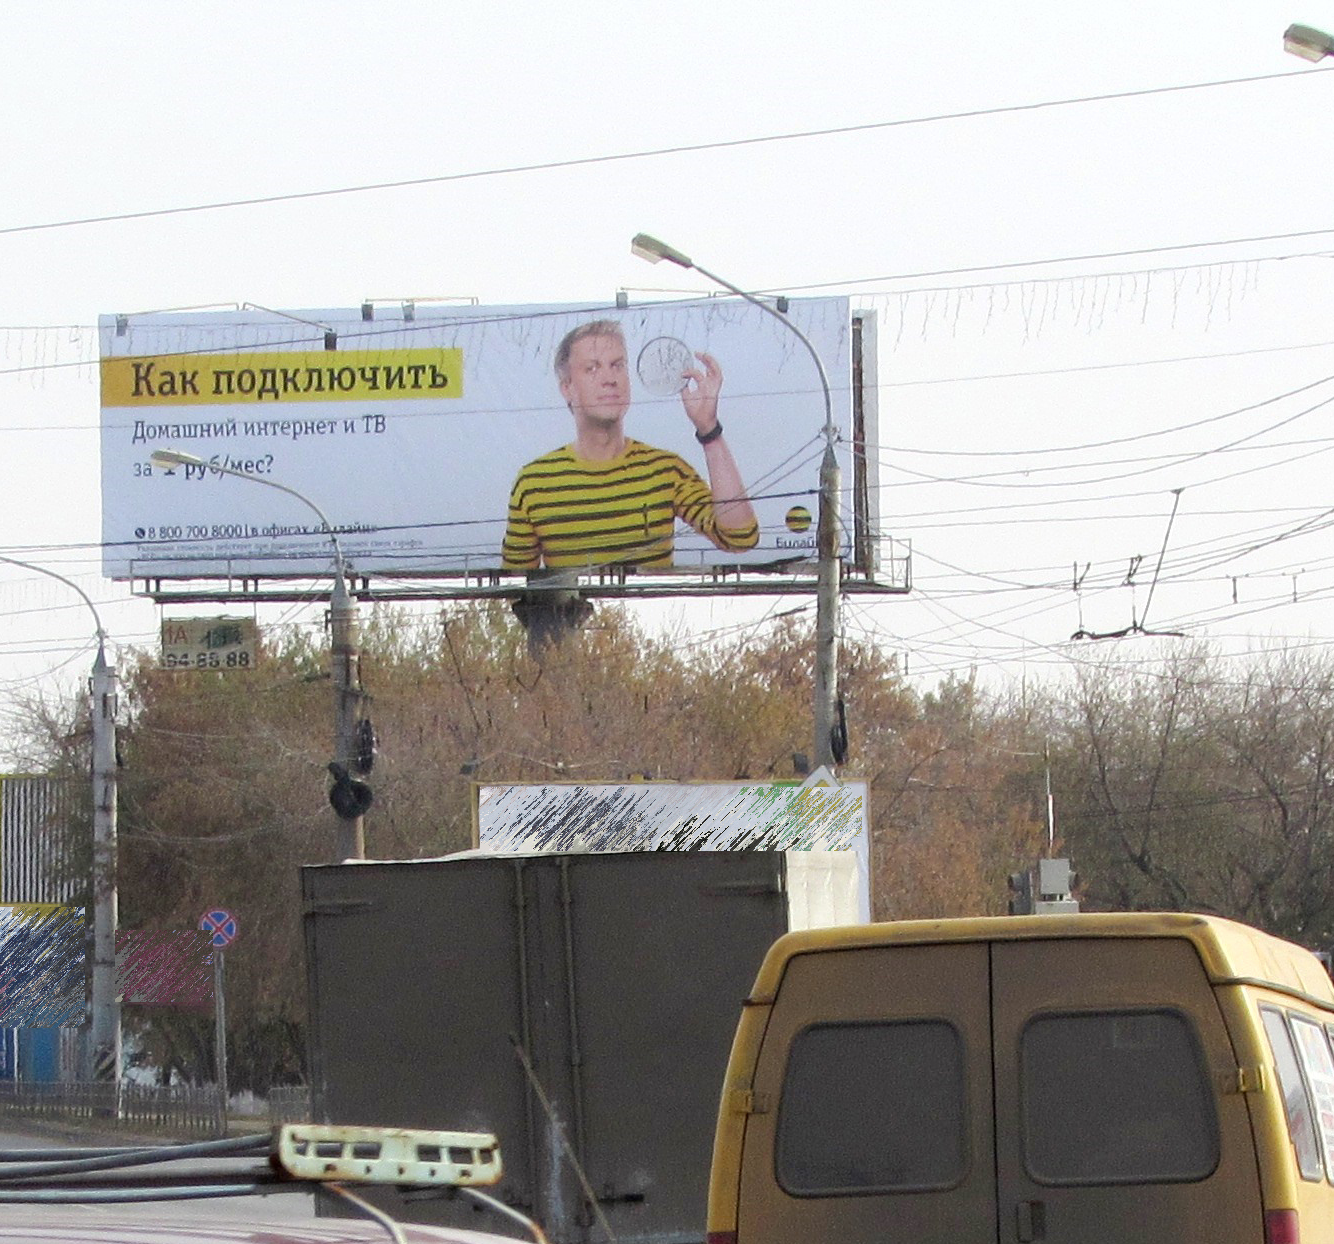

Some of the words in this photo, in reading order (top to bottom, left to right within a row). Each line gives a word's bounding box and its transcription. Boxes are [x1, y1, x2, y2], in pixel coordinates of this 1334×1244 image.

[132, 363, 199, 396] Как
[212, 364, 449, 399] подключить
[132, 419, 237, 444] Домашний
[244, 418, 336, 439] интернет
[344, 420, 355, 434] и
[363, 415, 386, 434] ТВ
[133, 462, 153, 476] за
[184, 456, 274, 480] руб/мес?
[160, 526, 182, 539] 800
[186, 525, 208, 538] 700
[212, 524, 242, 538] 8000
[776, 536, 817, 548] Билай
